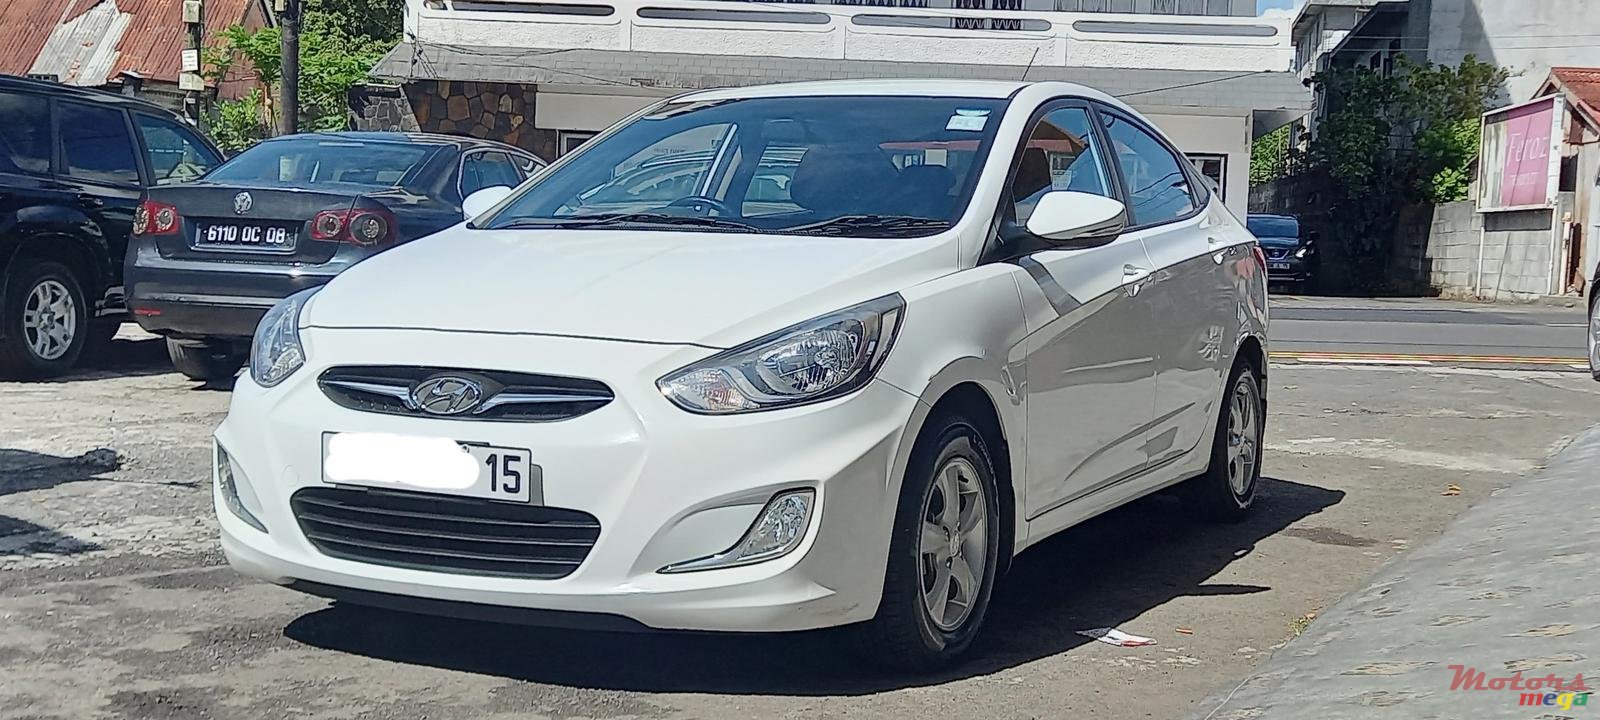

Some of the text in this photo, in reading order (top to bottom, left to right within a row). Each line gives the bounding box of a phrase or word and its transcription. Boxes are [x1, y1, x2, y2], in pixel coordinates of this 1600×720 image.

[1507, 133, 1549, 166] Feroz
[207, 225, 236, 242] 6110
[266, 227, 285, 243] 08
[485, 453, 521, 494] 15
